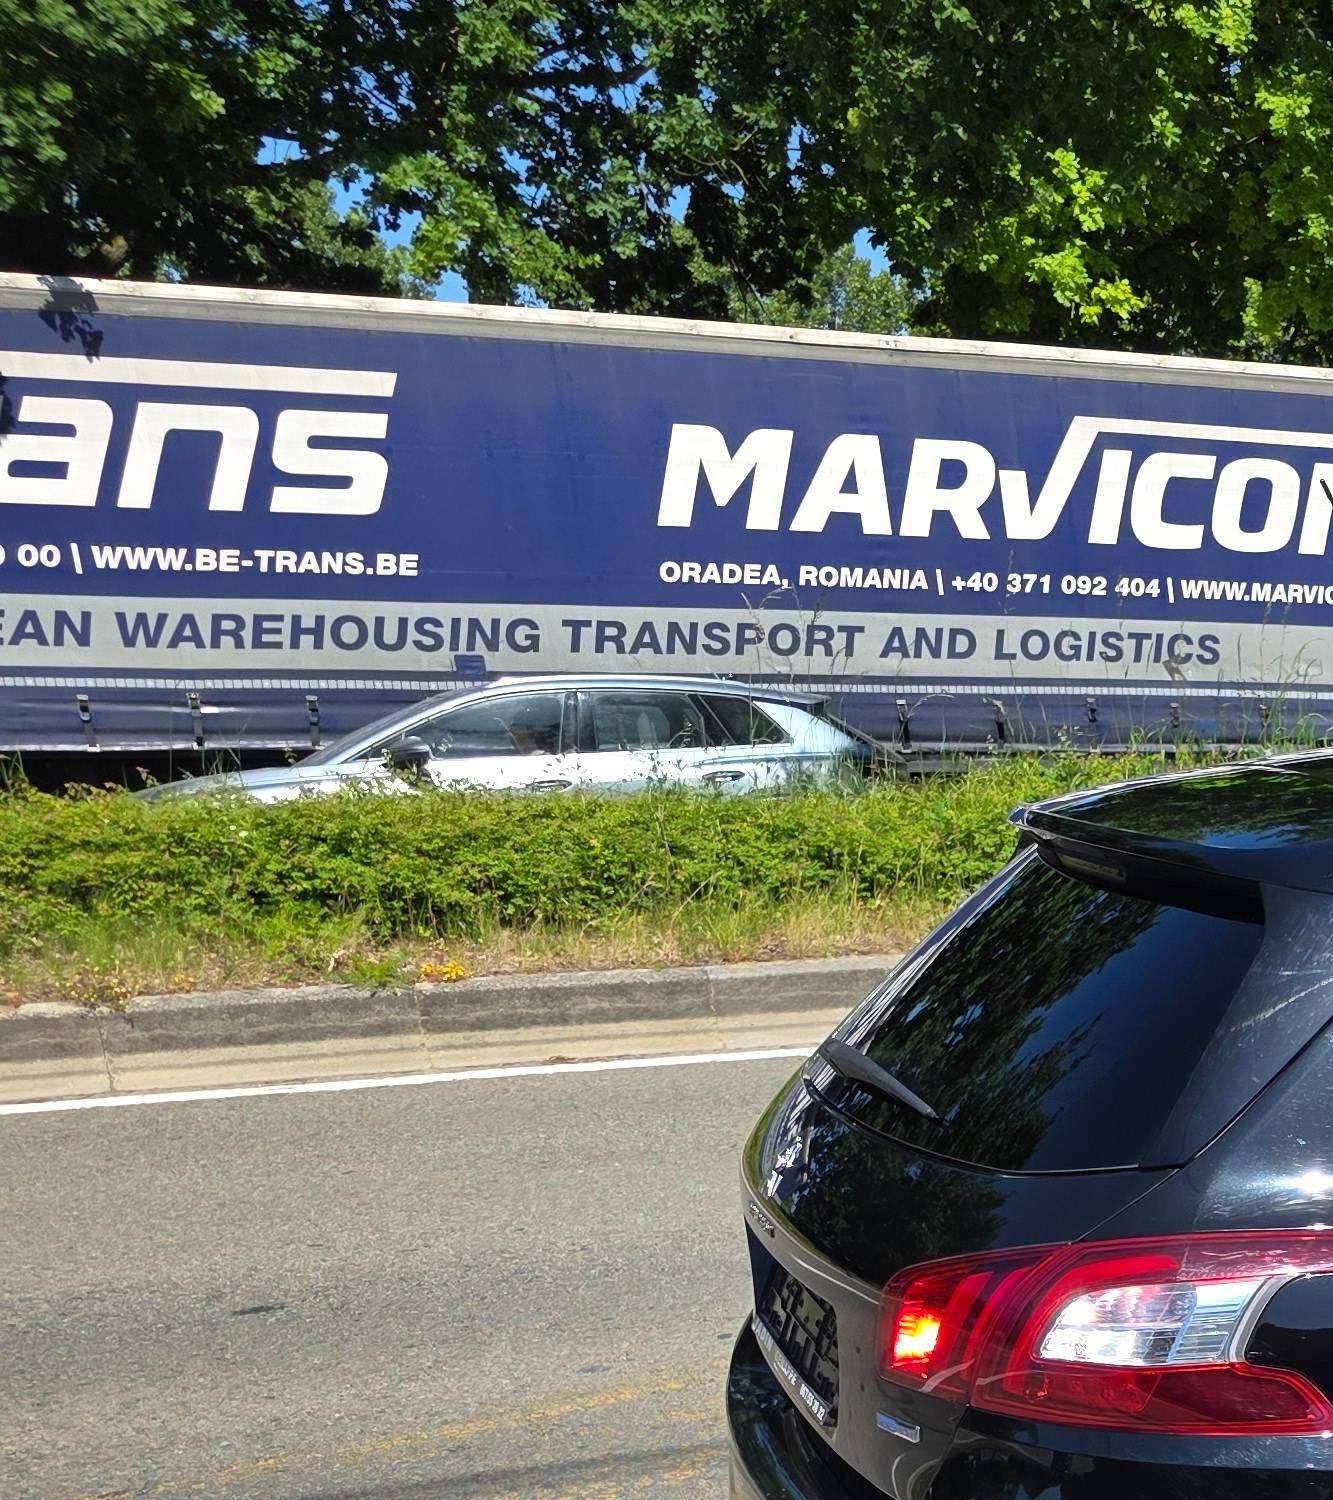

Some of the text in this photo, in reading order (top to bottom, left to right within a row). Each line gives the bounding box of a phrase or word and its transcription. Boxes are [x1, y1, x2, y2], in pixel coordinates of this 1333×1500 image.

[17, 543, 61, 568] 00
[90, 545, 419, 577] WWW.BE-TRANS.BE
[659, 560, 793, 590] ORADEA,
[798, 565, 929, 590] ROMANIA
[951, 571, 999, 593] +40
[1006, 572, 1051, 595] 371
[1060, 574, 1108, 596] 092
[1114, 576, 1161, 598] 404
[0, 608, 1221, 667] AN WAREHOUSING TRANSPORT AND LOGISTICS
